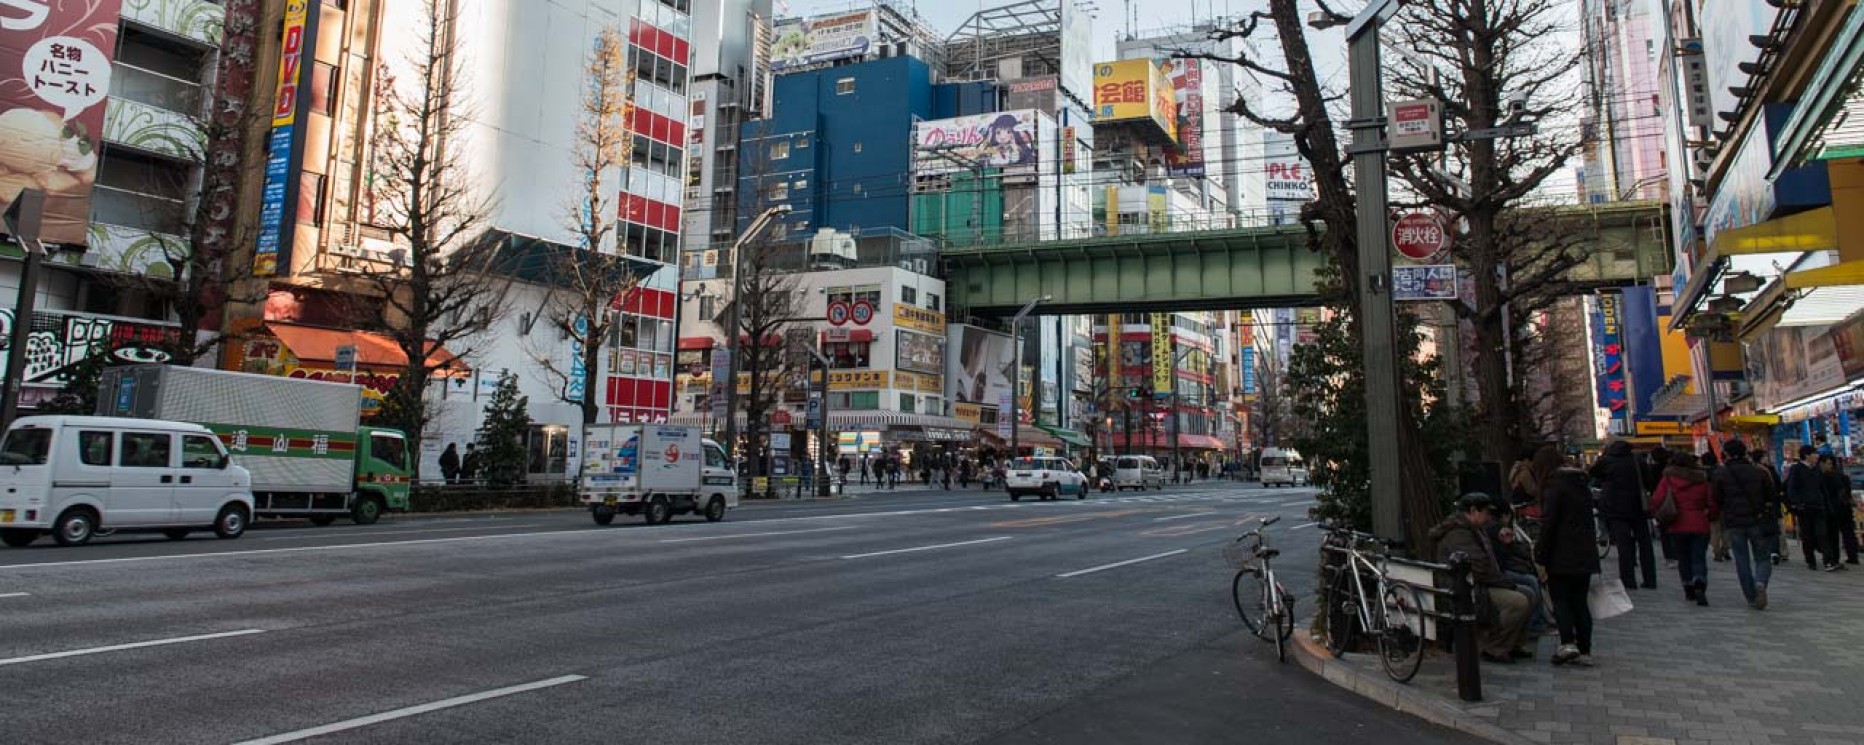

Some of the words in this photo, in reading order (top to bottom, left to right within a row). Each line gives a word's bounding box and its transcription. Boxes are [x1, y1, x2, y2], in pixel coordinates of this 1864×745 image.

[50, 43, 82, 61] 名物
[41, 60, 89, 75] ハニー
[277, 25, 303, 117] DVD
[35, 75, 96, 97] トースト
[1094, 80, 1145, 104] 会館
[925, 126, 983, 146] のうりん
[1264, 162, 1302, 180] PLE
[1398, 226, 1439, 245] 消火栓
[856, 306, 869, 318] 50
[809, 401, 818, 412] P
